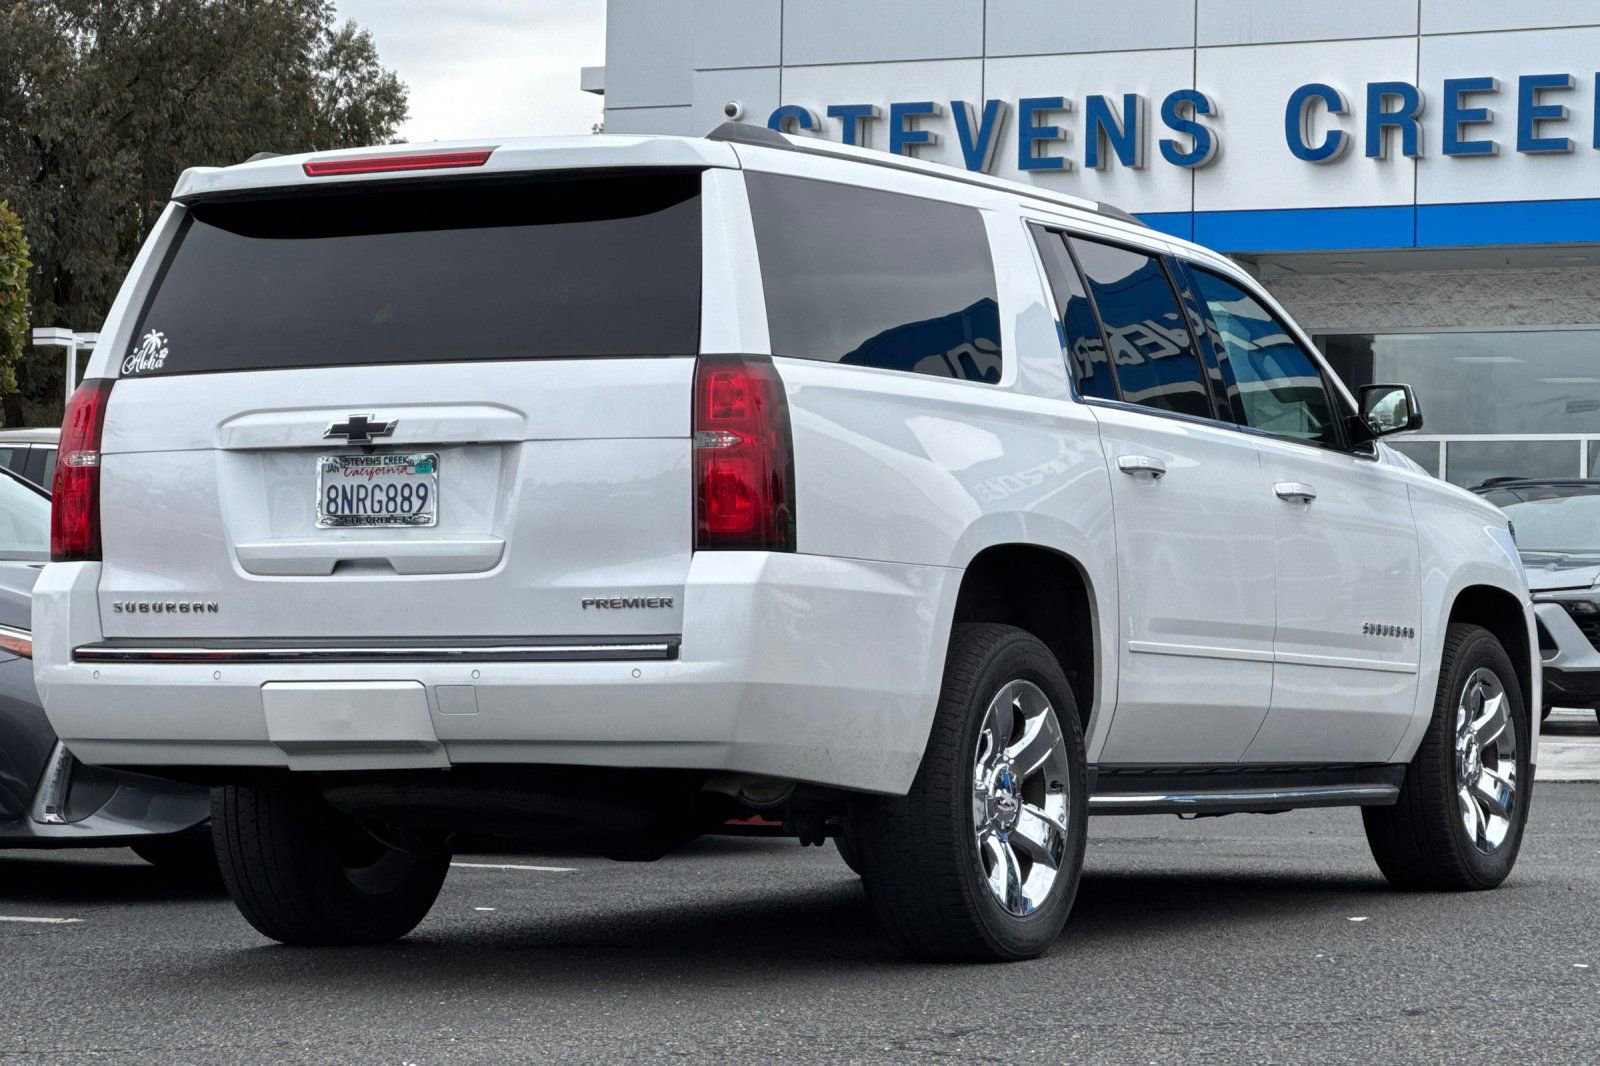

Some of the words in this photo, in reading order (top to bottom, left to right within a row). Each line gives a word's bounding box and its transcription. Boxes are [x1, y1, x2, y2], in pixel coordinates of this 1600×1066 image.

[1285, 72, 1600, 162] CREE
[122, 349, 164, 374] Aloha
[344, 456, 381, 465] STEVENS
[383, 455, 408, 465] CREEK
[326, 464, 339, 473] JAN
[344, 465, 410, 481] California
[326, 482, 429, 514] 8NRG889
[113, 601, 219, 614] SUBURBAN
[581, 596, 673, 610] PREMIER
